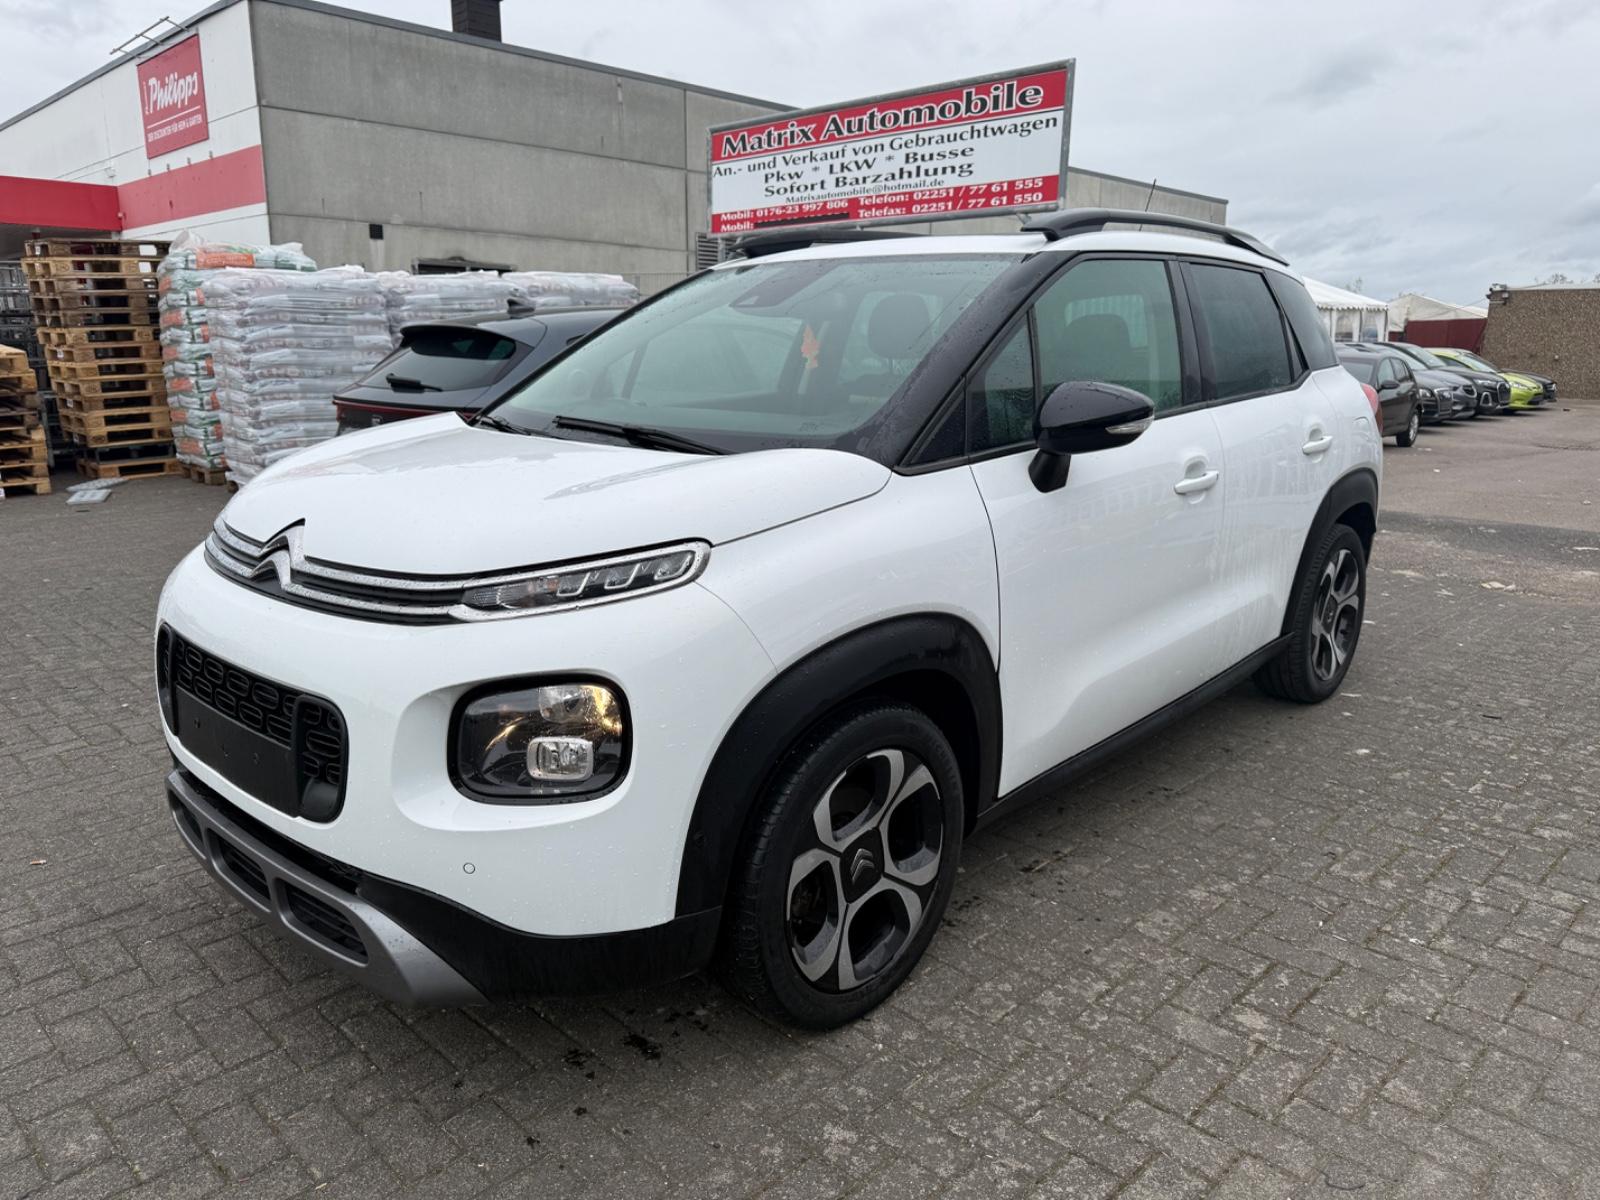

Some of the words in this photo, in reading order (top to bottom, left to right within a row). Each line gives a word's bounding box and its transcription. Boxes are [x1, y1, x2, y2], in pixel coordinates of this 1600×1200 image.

[148, 72, 198, 114] Philipps
[722, 121, 816, 157] Matrix
[820, 80, 1044, 141] Automobile
[748, 156, 777, 173] und
[782, 145, 847, 166] Verkauf
[852, 142, 884, 157] von
[889, 116, 1058, 152] Gebrauchtwagen
[764, 170, 804, 184] Pkw
[829, 158, 877, 175] LKW
[904, 146, 975, 165] Busse
[764, 179, 826, 197] Sofort
[835, 161, 975, 189] Barzahlung
[784, 178, 945, 204] Matrixautomobile@hotmail.de
[858, 195, 909, 206] Telefon:
[913, 188, 954, 201] 02251
[968, 184, 987, 195] 77
[991, 182, 1008, 193] 61
[1014, 177, 1043, 190] 555
[858, 207, 907, 218] Telefax:
[912, 201, 953, 213] 02251
[967, 198, 986, 208] 77
[990, 195, 1007, 206] 61
[1013, 192, 1043, 203] 550
[720, 210, 754, 222] Mobil:
[756, 204, 800, 217] 0176-23
[801, 201, 823, 213] 997
[720, 220, 754, 233] Mobil:
